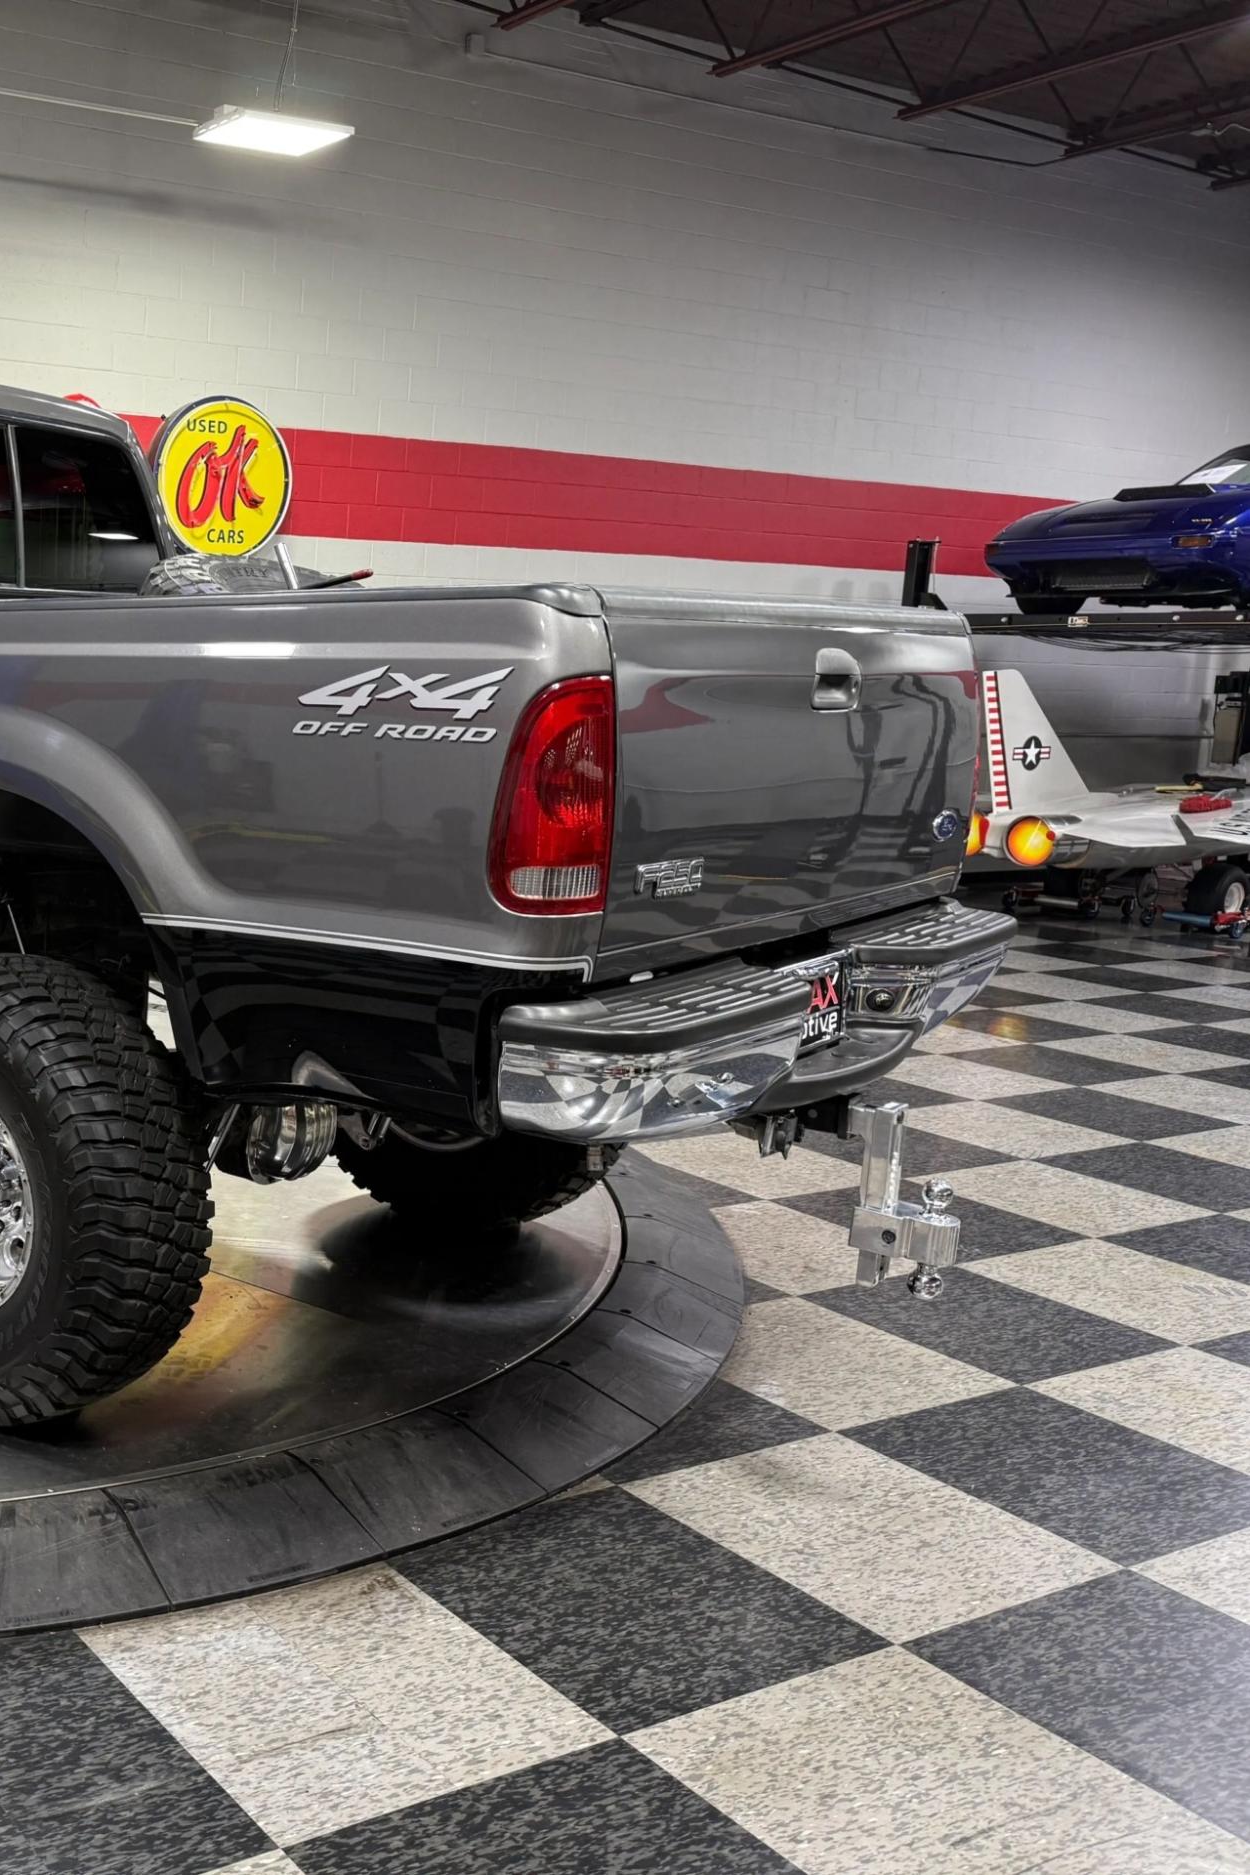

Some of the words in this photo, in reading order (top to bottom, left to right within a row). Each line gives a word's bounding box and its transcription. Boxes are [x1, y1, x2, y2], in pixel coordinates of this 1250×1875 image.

[186, 419, 228, 434] USED
[176, 424, 266, 529] OK
[207, 528, 245, 545] CARS
[292, 720, 370, 737] OFF
[374, 723, 498, 743] ROAD
[636, 857, 705, 892] F250
